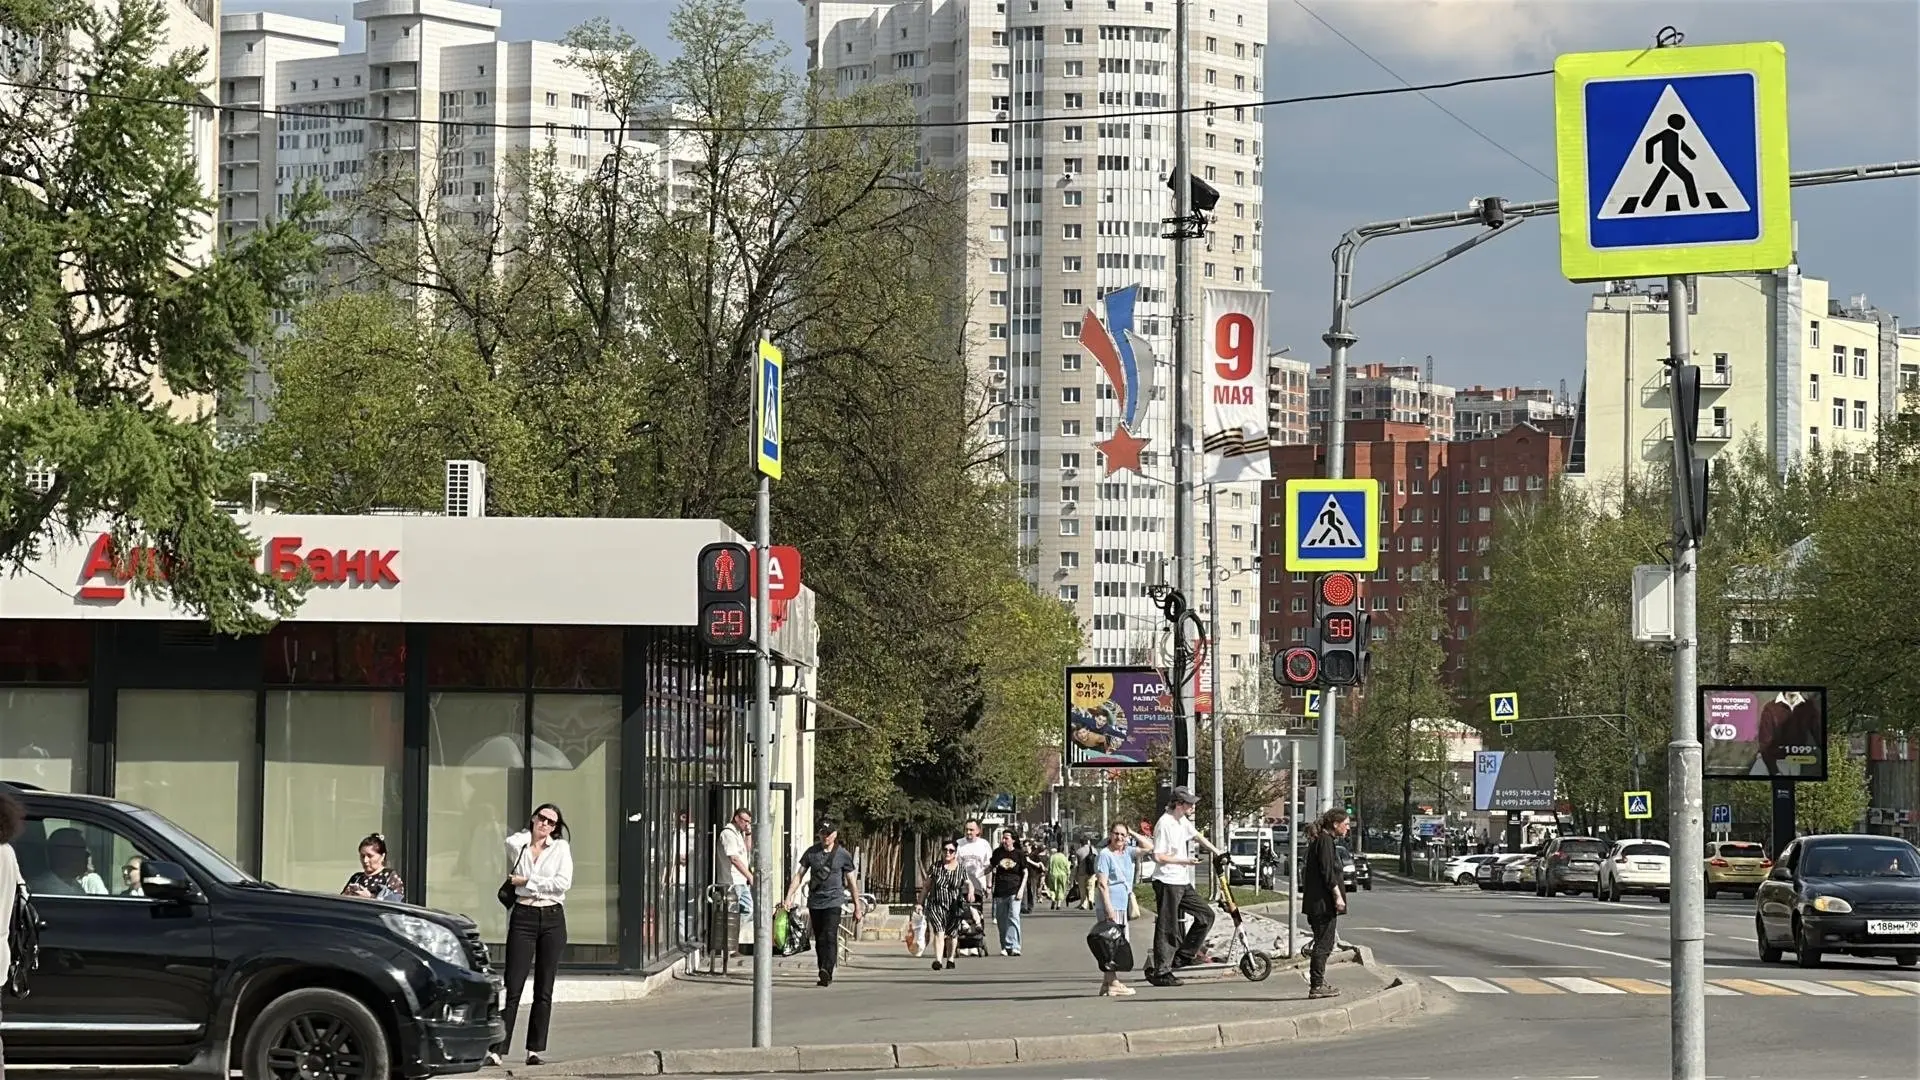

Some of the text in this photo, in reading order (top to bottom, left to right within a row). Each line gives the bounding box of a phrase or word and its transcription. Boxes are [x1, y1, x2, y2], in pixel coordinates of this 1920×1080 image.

[1214, 312, 1254, 381] 9
[1213, 385, 1254, 405] МАЯ
[268, 537, 399, 582] Банк
[769, 557, 783, 580] А
[711, 610, 743, 635] 29
[1329, 618, 1352, 638] 58
[1133, 683, 1165, 694] ПАР
[1714, 726, 1733, 736] wb
